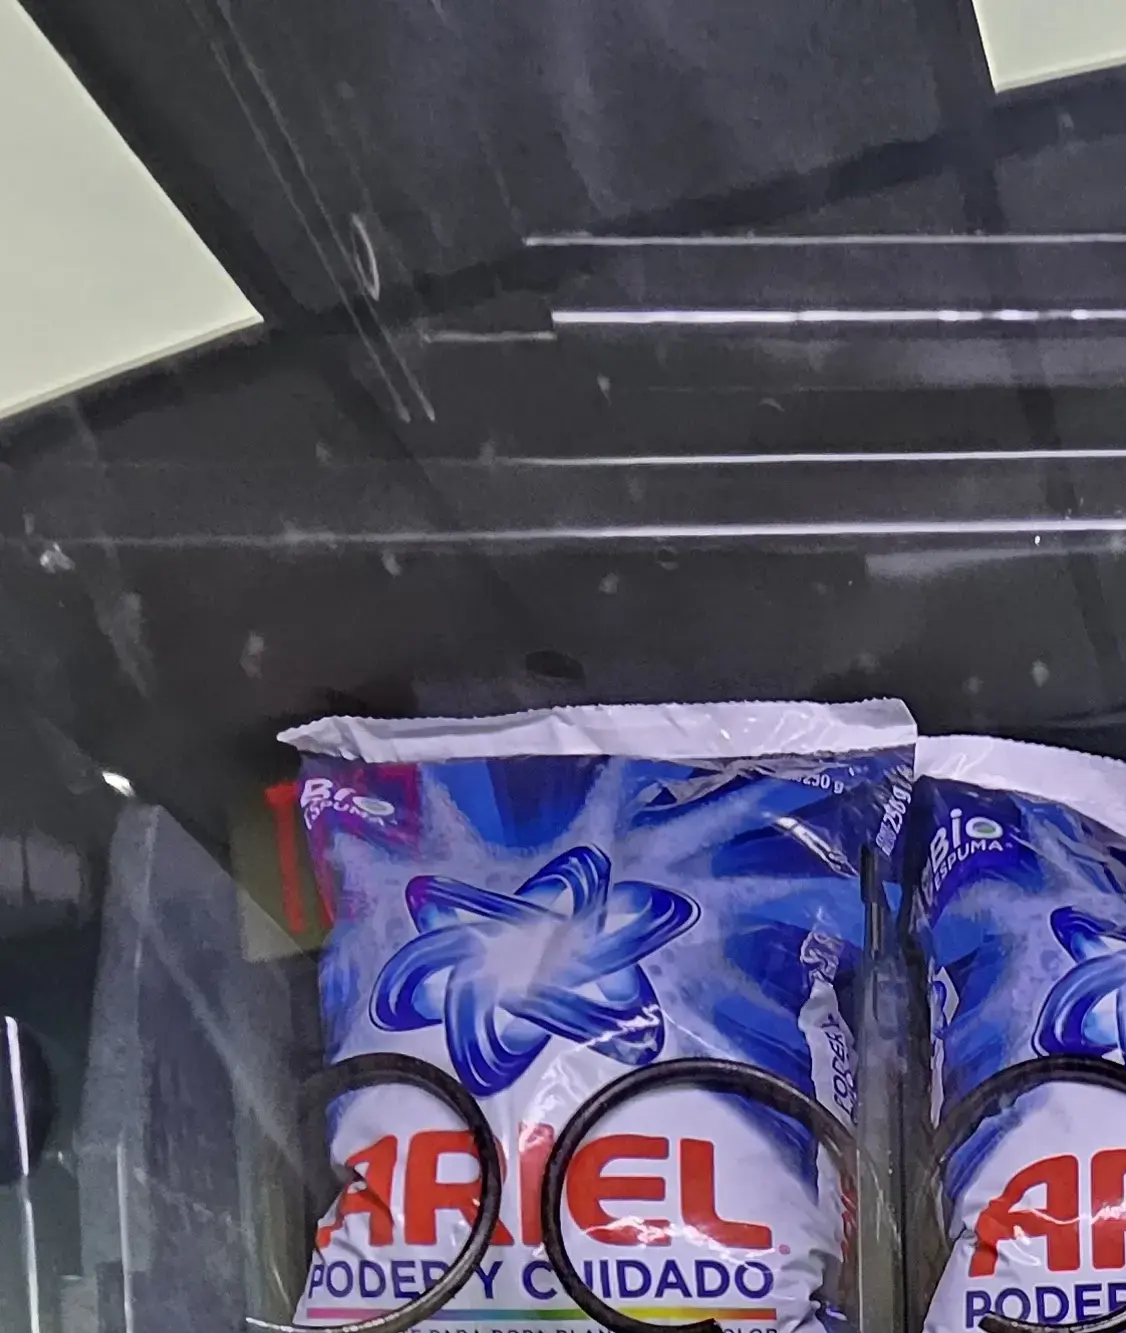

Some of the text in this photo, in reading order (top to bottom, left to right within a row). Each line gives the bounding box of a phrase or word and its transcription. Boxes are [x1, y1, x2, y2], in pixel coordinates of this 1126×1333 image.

[316, 1121, 774, 1252] ARIEL
[307, 1259, 456, 1299] PODER
[481, 1260, 504, 1299] Y
